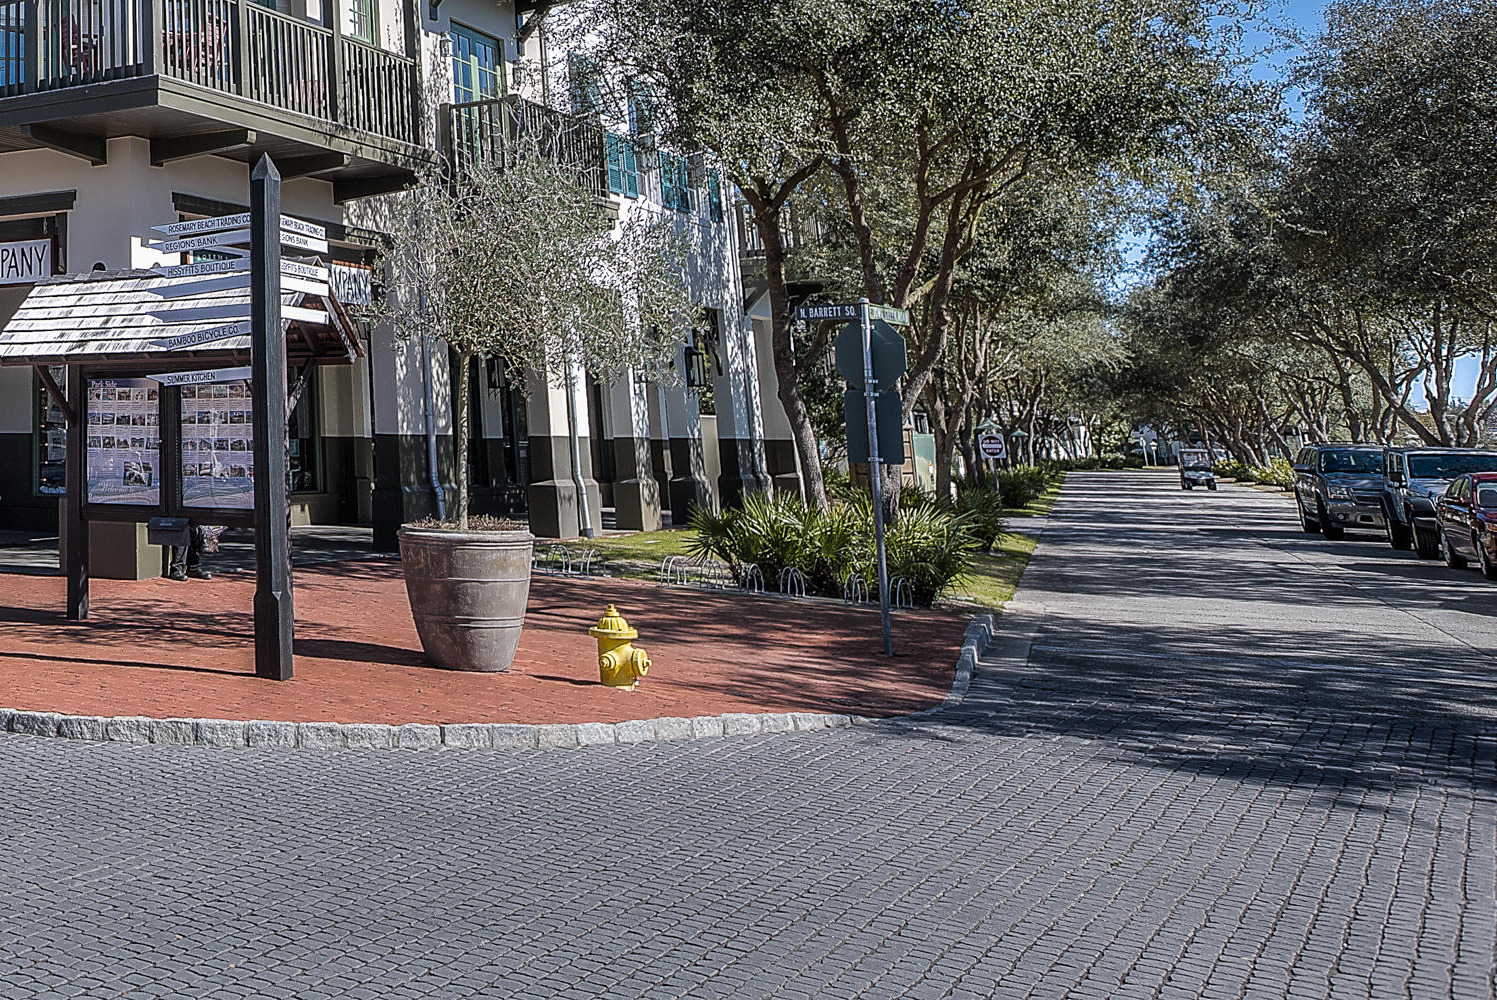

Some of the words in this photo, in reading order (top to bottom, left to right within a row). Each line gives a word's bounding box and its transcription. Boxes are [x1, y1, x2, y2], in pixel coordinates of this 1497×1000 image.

[168, 222, 198, 234] ROSEMARY
[197, 219, 215, 230] BEACH
[214, 216, 241, 228] TRADING
[165, 239, 195, 251] REGIONS
[197, 236, 218, 248] BANK
[295, 236, 309, 247] BANK
[167, 265, 199, 277] HISSYFITS
[200, 260, 235, 272] BOUTIQUE
[297, 264, 319, 277] BOUTIQUE
[809, 306, 841, 318] BARRETT
[168, 335, 196, 348] BAMBOO
[197, 327, 226, 341] BICYCLE
[167, 373, 190, 384] SUMMER
[191, 371, 215, 382] KITCHEN
